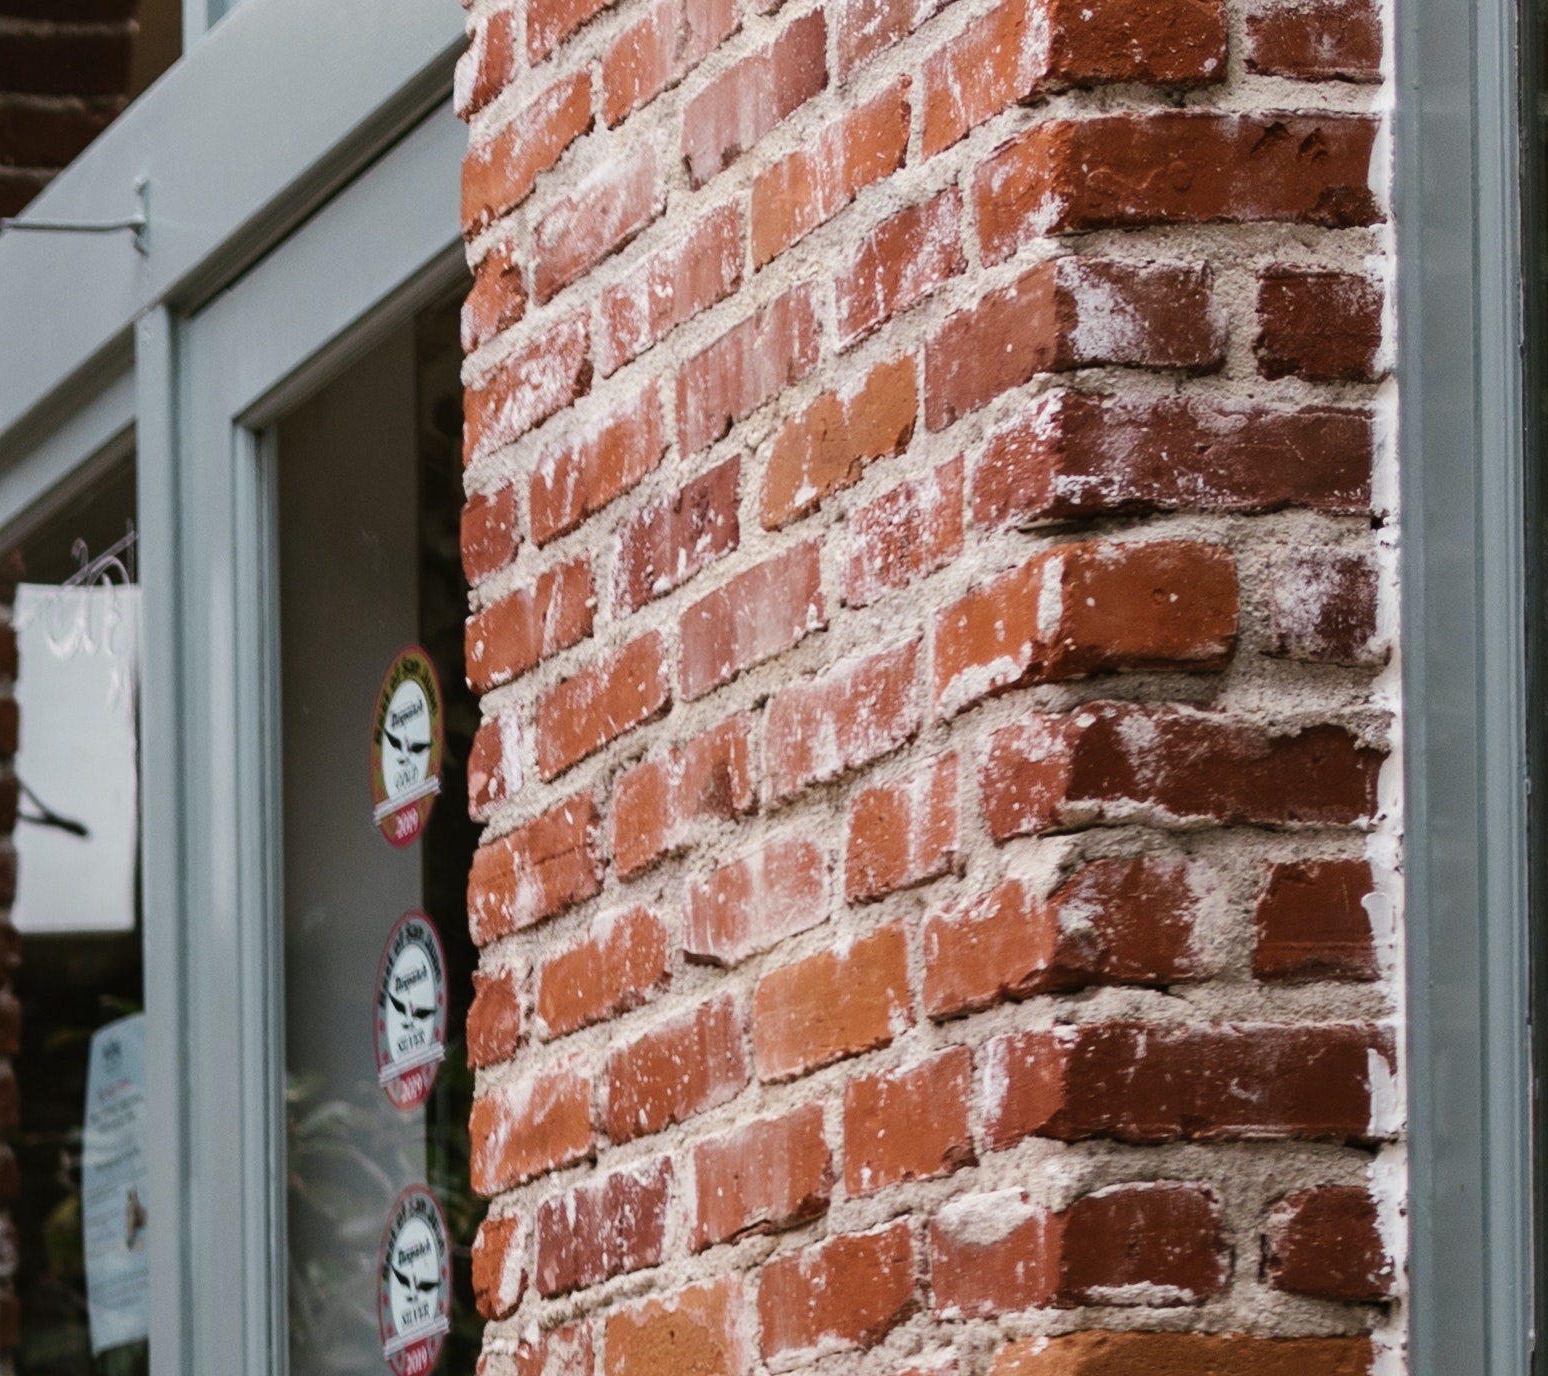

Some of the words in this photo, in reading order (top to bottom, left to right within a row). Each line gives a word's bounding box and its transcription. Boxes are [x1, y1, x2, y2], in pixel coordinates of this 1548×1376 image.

[395, 807, 419, 839] 2019
[400, 1073, 424, 1103] 2019
[406, 1345, 428, 1376] 2019
